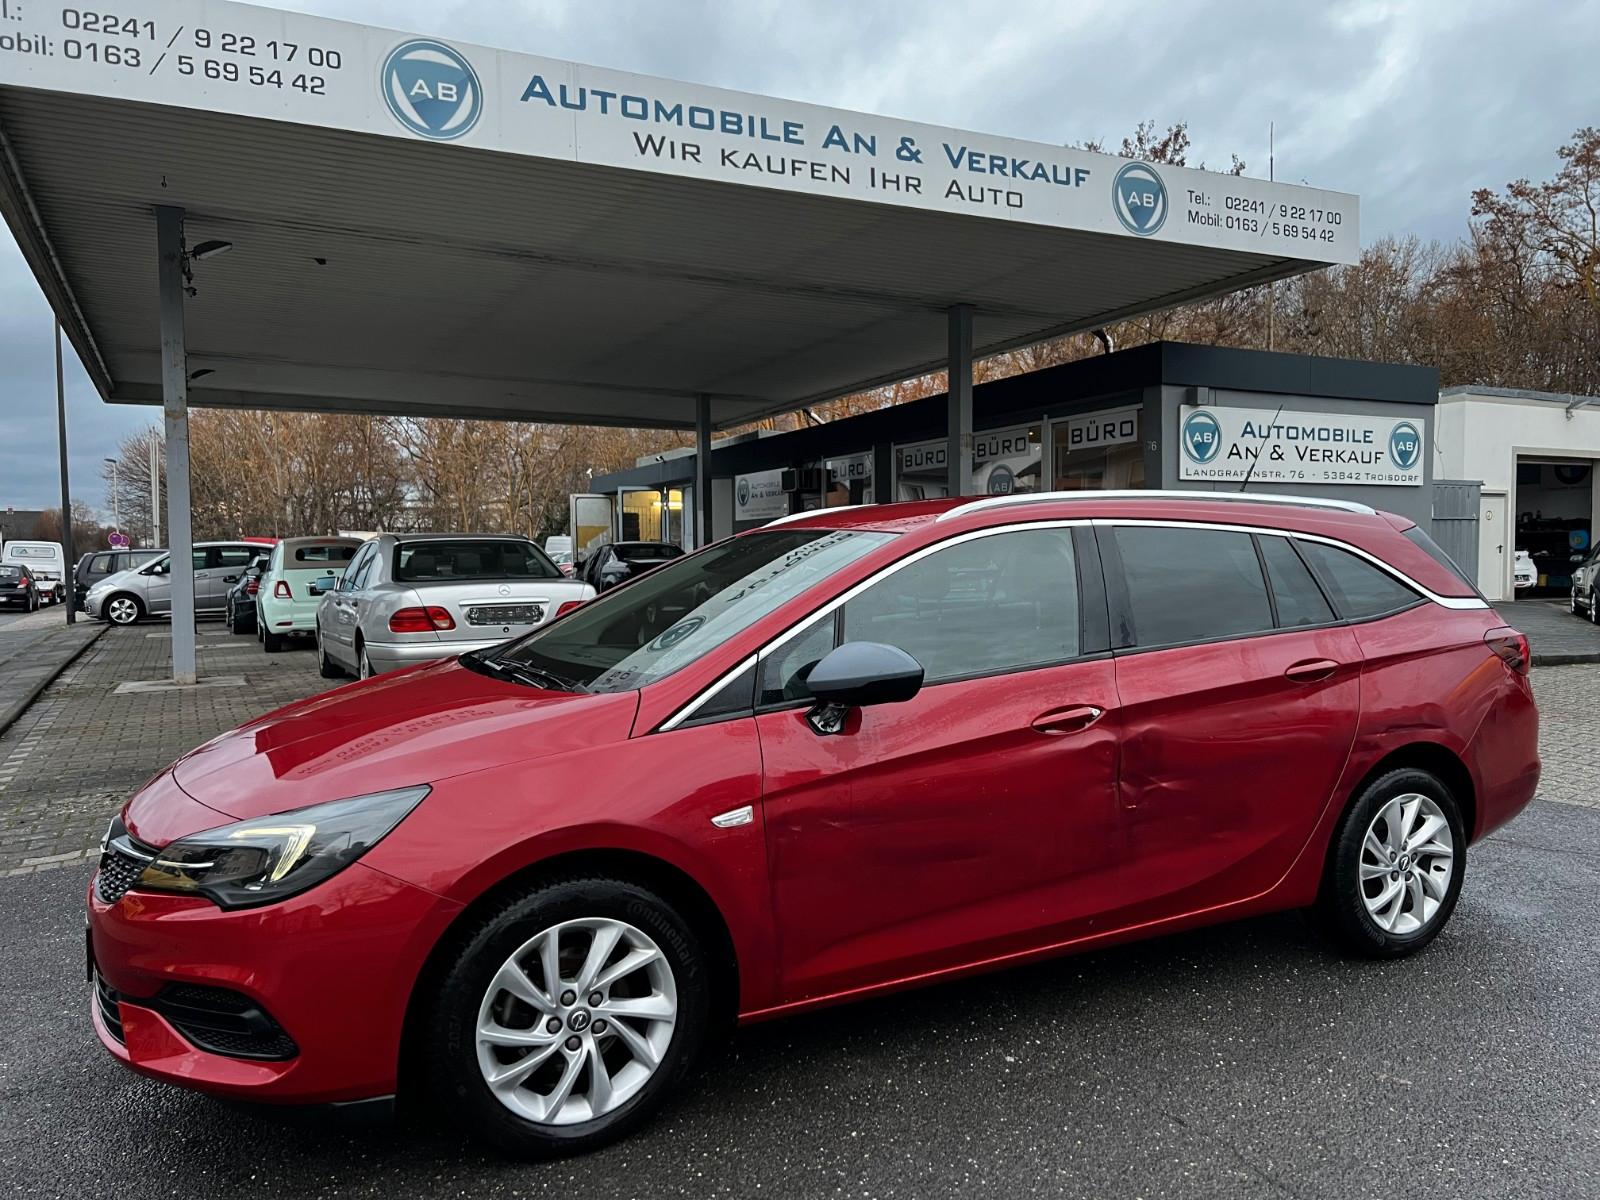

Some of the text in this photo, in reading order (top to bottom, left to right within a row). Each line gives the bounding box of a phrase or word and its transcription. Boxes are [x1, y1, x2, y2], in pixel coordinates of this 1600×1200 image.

[62, 8, 155, 40] 02241
[167, 25, 183, 49] /
[195, 28, 211, 48] 9
[221, 33, 256, 56] 22
[266, 41, 298, 62] 17
[308, 47, 341, 70] 00
[0, 32, 325, 96] obil: 0163 / 5 69 54 42
[410, 78, 458, 104] AB
[520, 74, 1091, 188] AUTOMOBILE AN & VERKAUF
[633, 131, 1022, 209] WIR KAUFEN IHR AUTO
[1128, 190, 1155, 207] AB
[1187, 189, 1341, 225] Tel.: 02241 / 9 22 17 00
[1188, 209, 1335, 243] Mobil: 0163 / 5 69 54 42
[1071, 419, 1135, 445] BÜRO
[1192, 431, 1213, 443] AB
[1240, 420, 1374, 444] AUTOMOBILE
[904, 449, 946, 468] BÜRO
[976, 436, 1027, 459] BÜRO
[1227, 442, 1385, 465] AN & VERKAUF
[1397, 441, 1414, 452] AB
[992, 482, 1009, 493] AB
[1289, 470, 1305, 479] 76
[1323, 471, 1361, 480] 53842
[1364, 472, 1420, 482] TROISDORF
